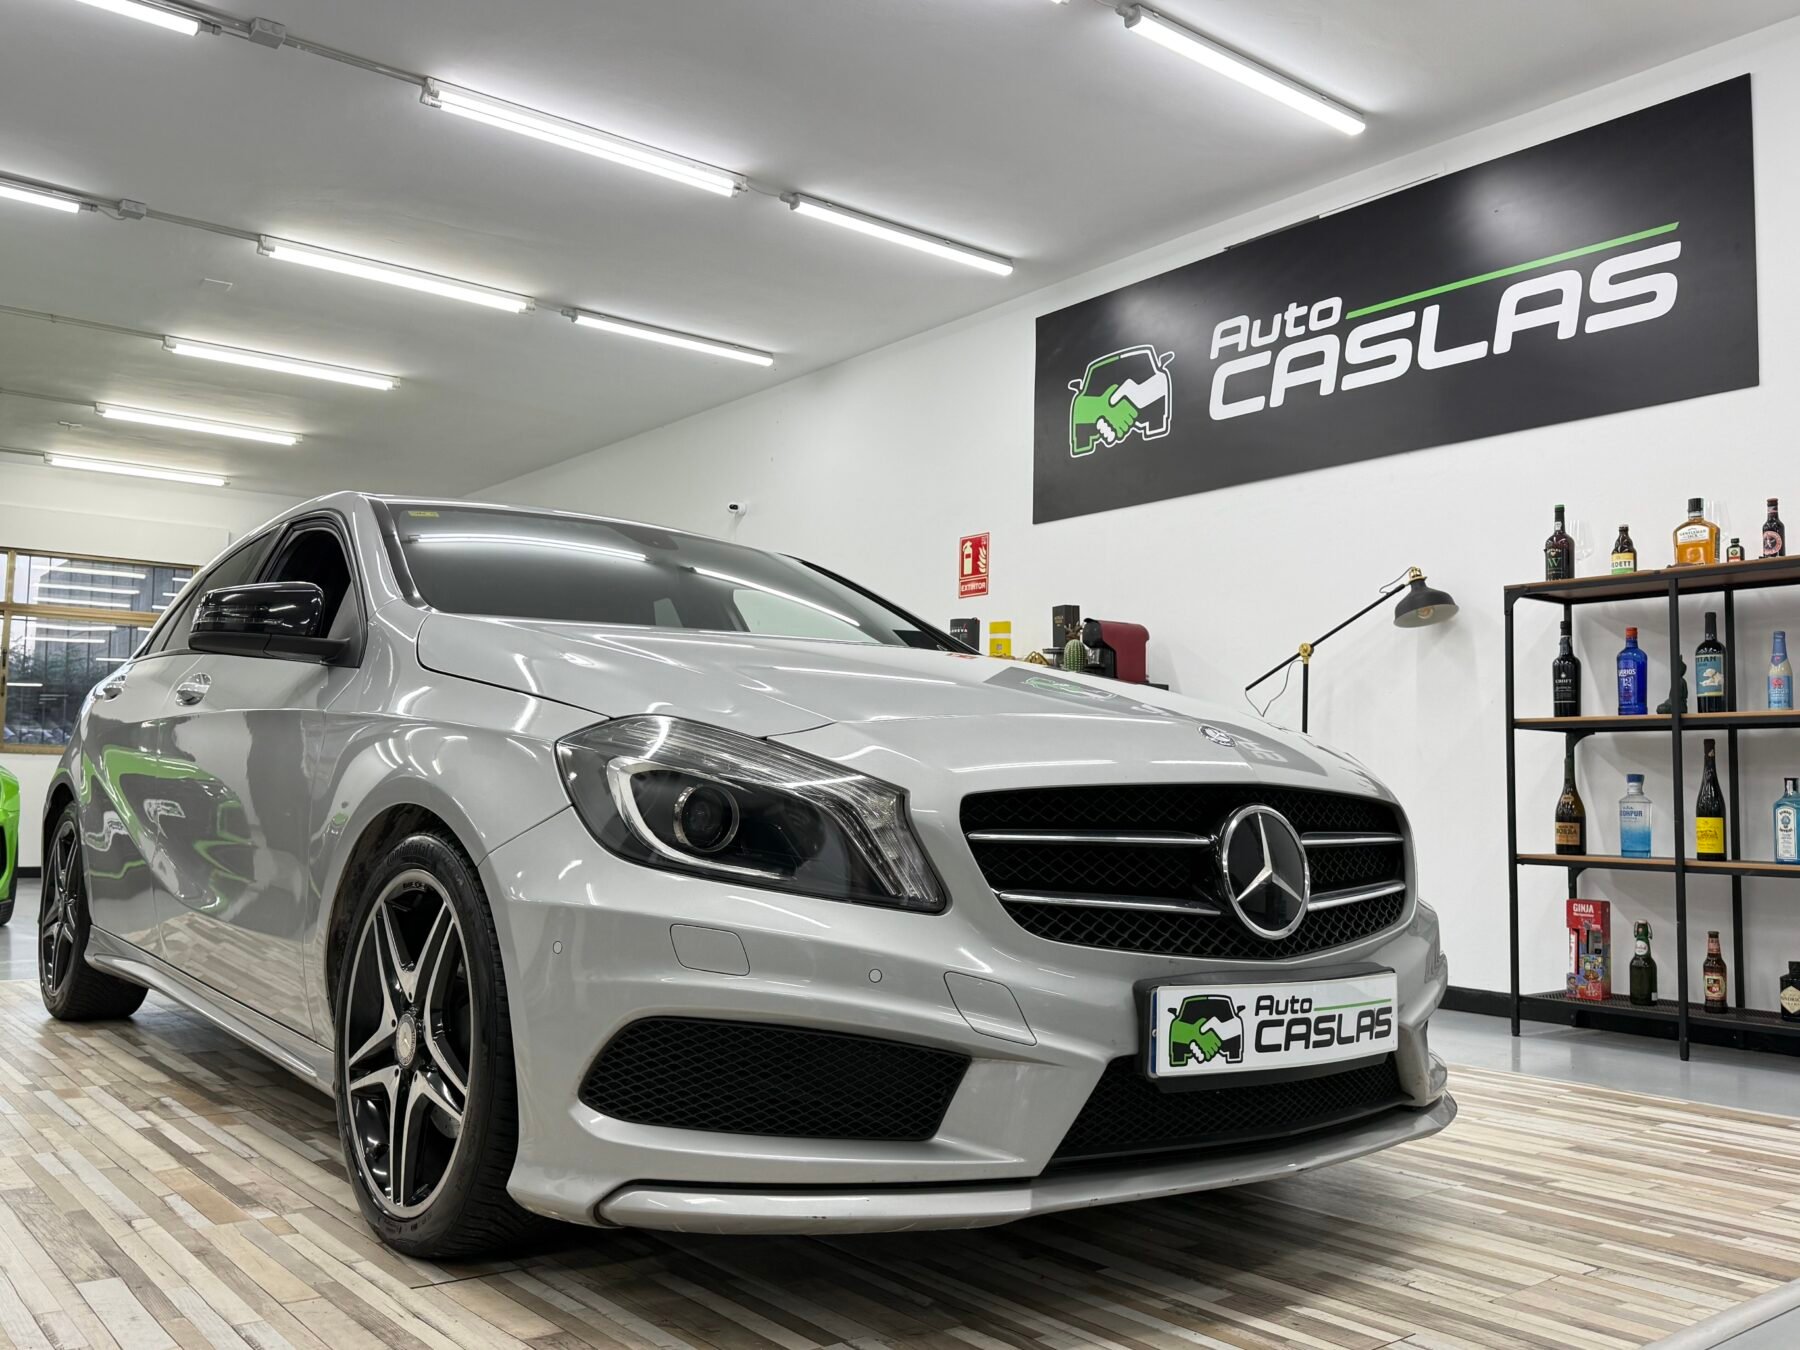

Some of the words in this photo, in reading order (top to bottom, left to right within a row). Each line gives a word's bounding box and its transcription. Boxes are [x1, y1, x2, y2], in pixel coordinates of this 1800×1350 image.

[1209, 296, 1343, 360] Auto
[1209, 241, 1682, 421] CASLAS
[960, 581, 986, 592] EXTINTOR
[1572, 902, 1595, 914] GINJA
[1254, 994, 1313, 1017] Auto
[1254, 1006, 1393, 1054] CASLAS
